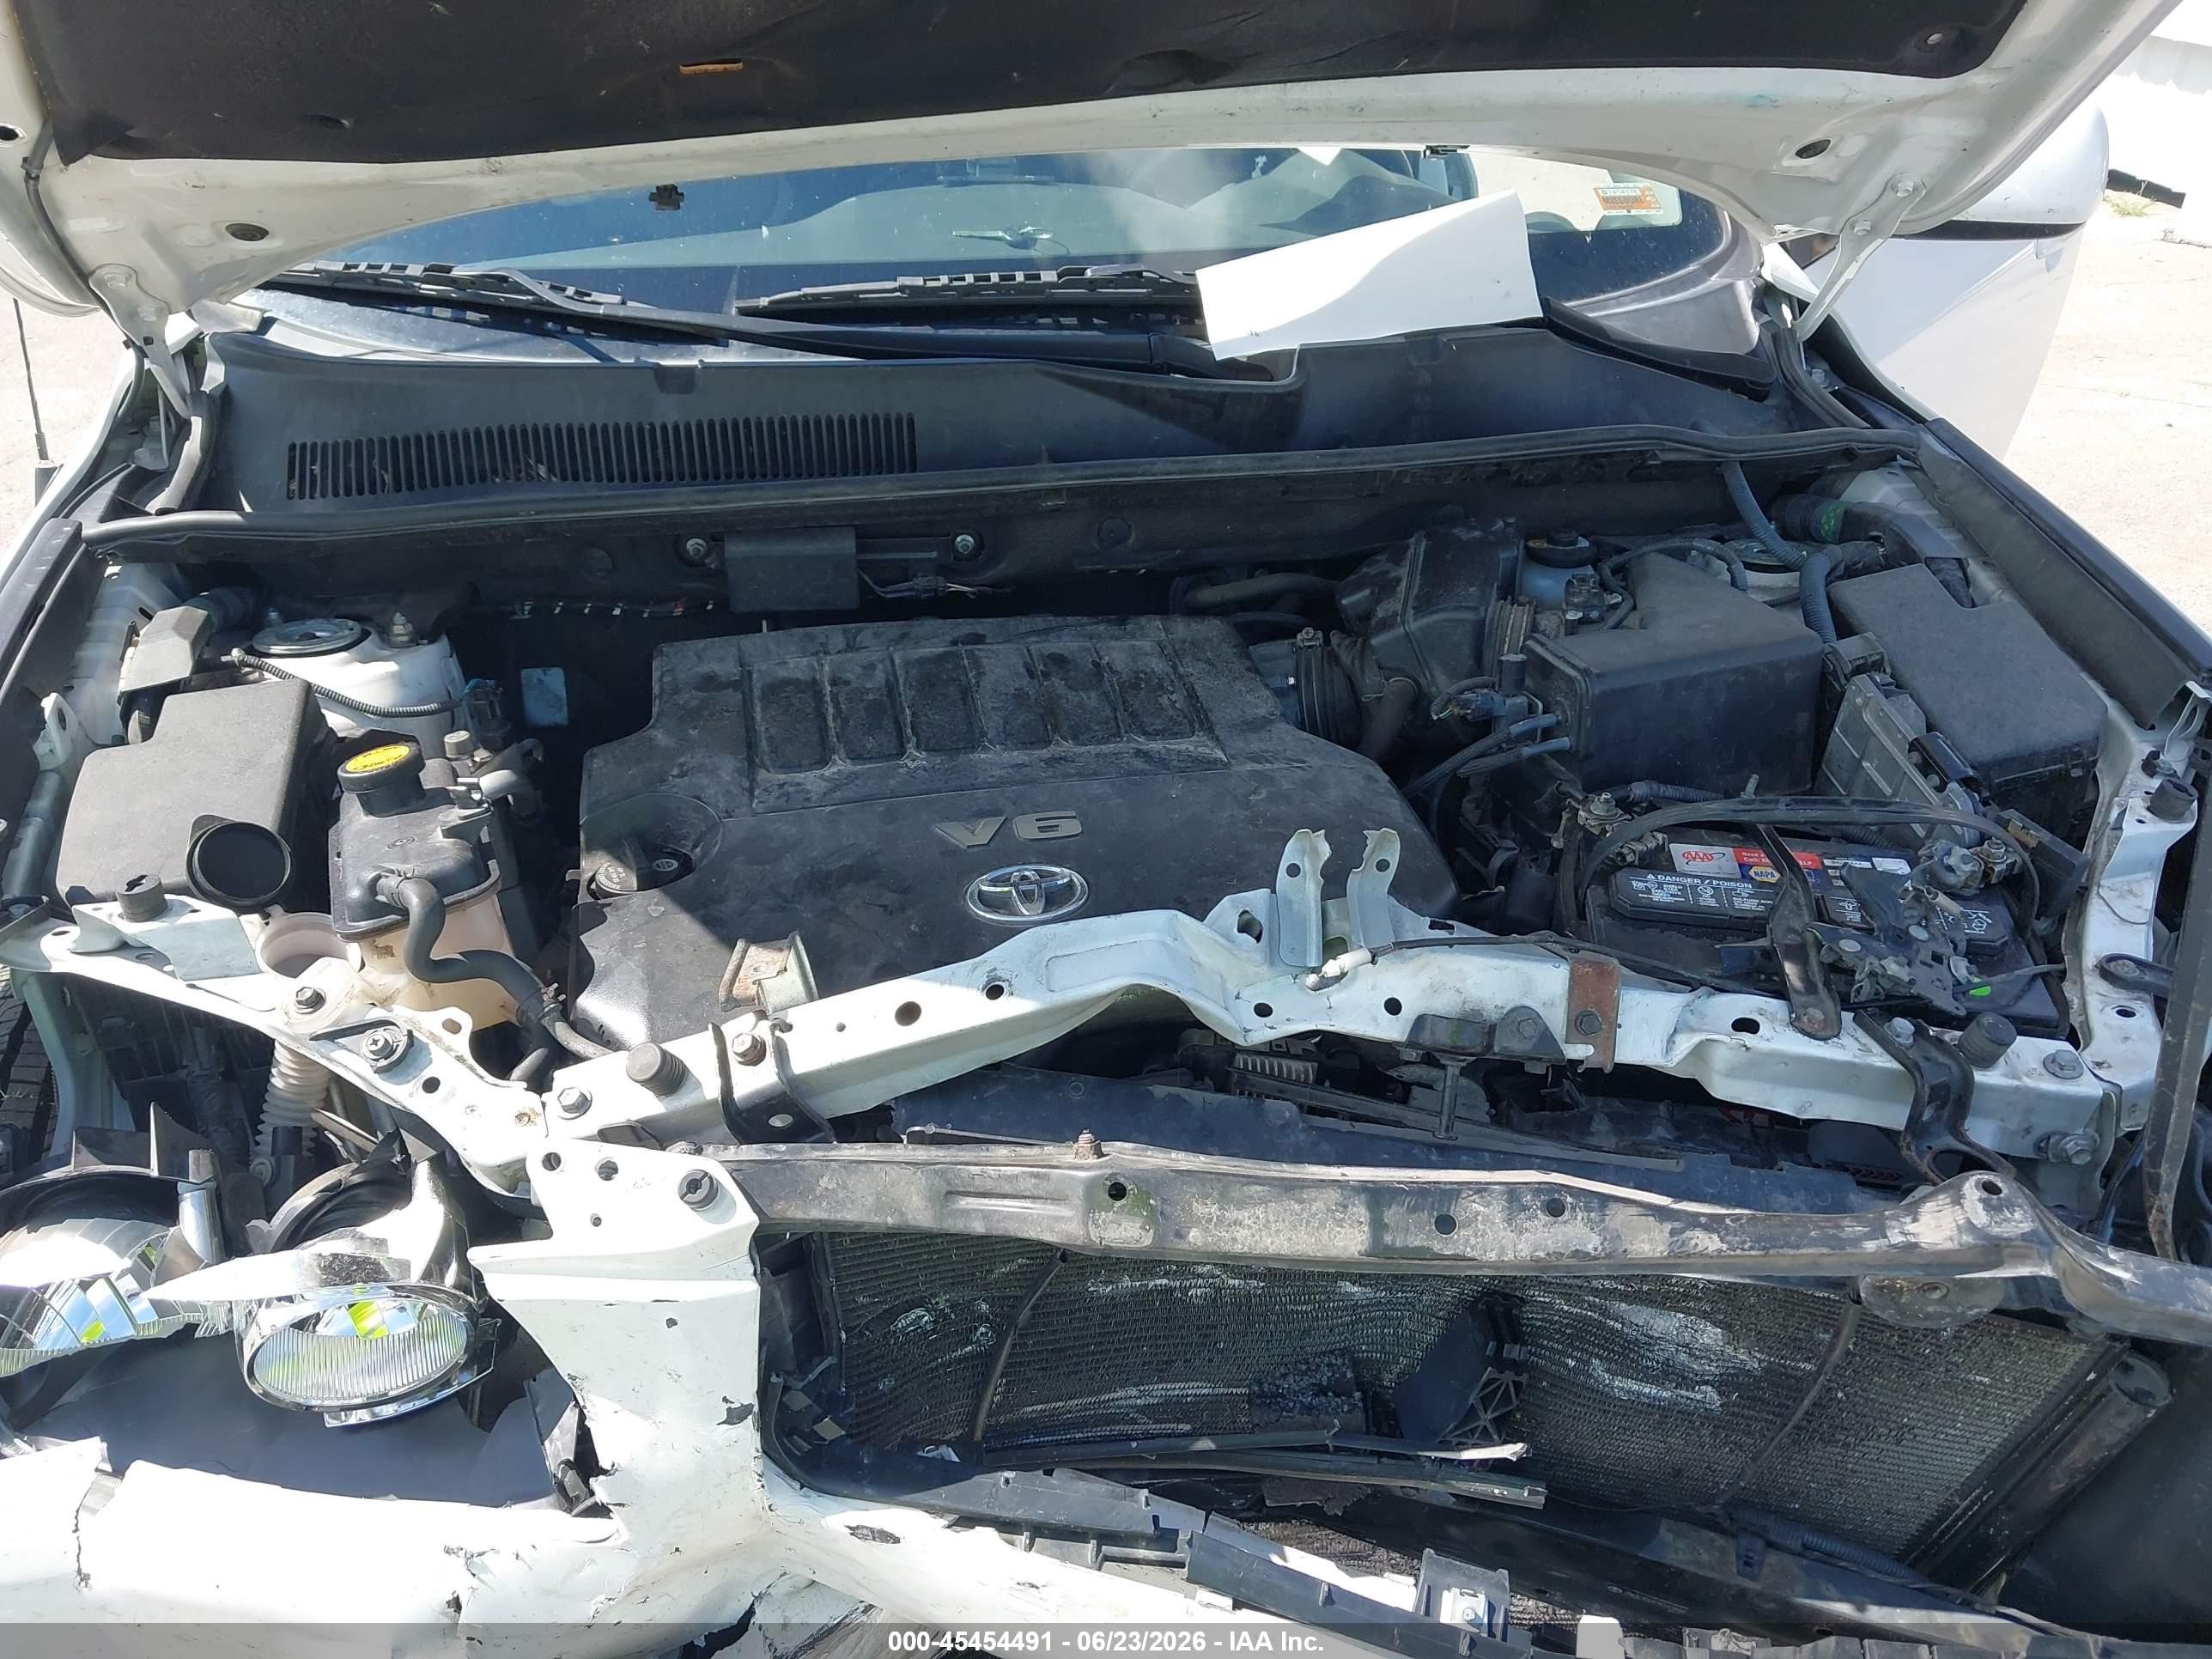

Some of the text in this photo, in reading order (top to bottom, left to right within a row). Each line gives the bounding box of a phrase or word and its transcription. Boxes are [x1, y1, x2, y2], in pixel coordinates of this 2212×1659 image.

[933, 811, 1083, 848] V6
[1683, 851, 1713, 862] AAA
[1753, 870, 1776, 878] NAPA
[1657, 875, 1702, 884] DANGER
[1712, 880, 1753, 889] POISON
